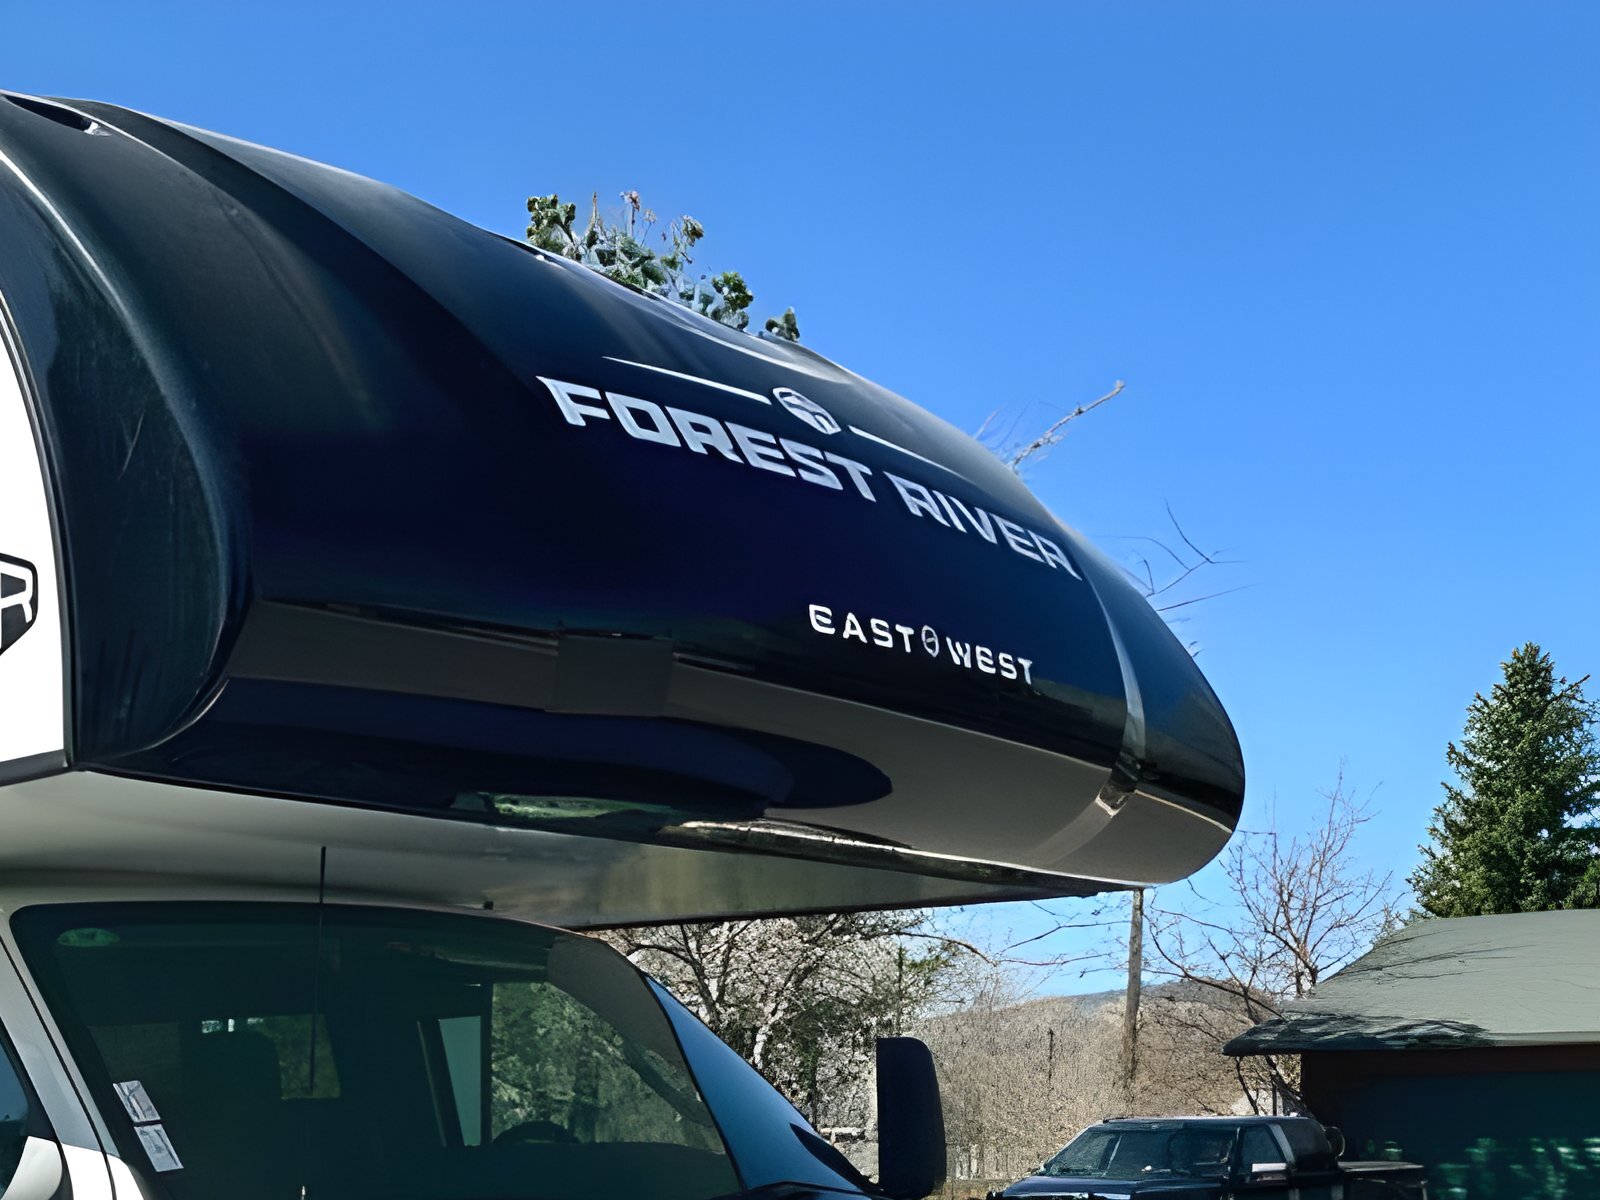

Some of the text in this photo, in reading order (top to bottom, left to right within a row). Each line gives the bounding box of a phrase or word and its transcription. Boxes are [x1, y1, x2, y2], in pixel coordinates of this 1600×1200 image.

[536, 375, 1082, 580] FOREST RIVER
[809, 604, 1033, 685] EAST WEST
